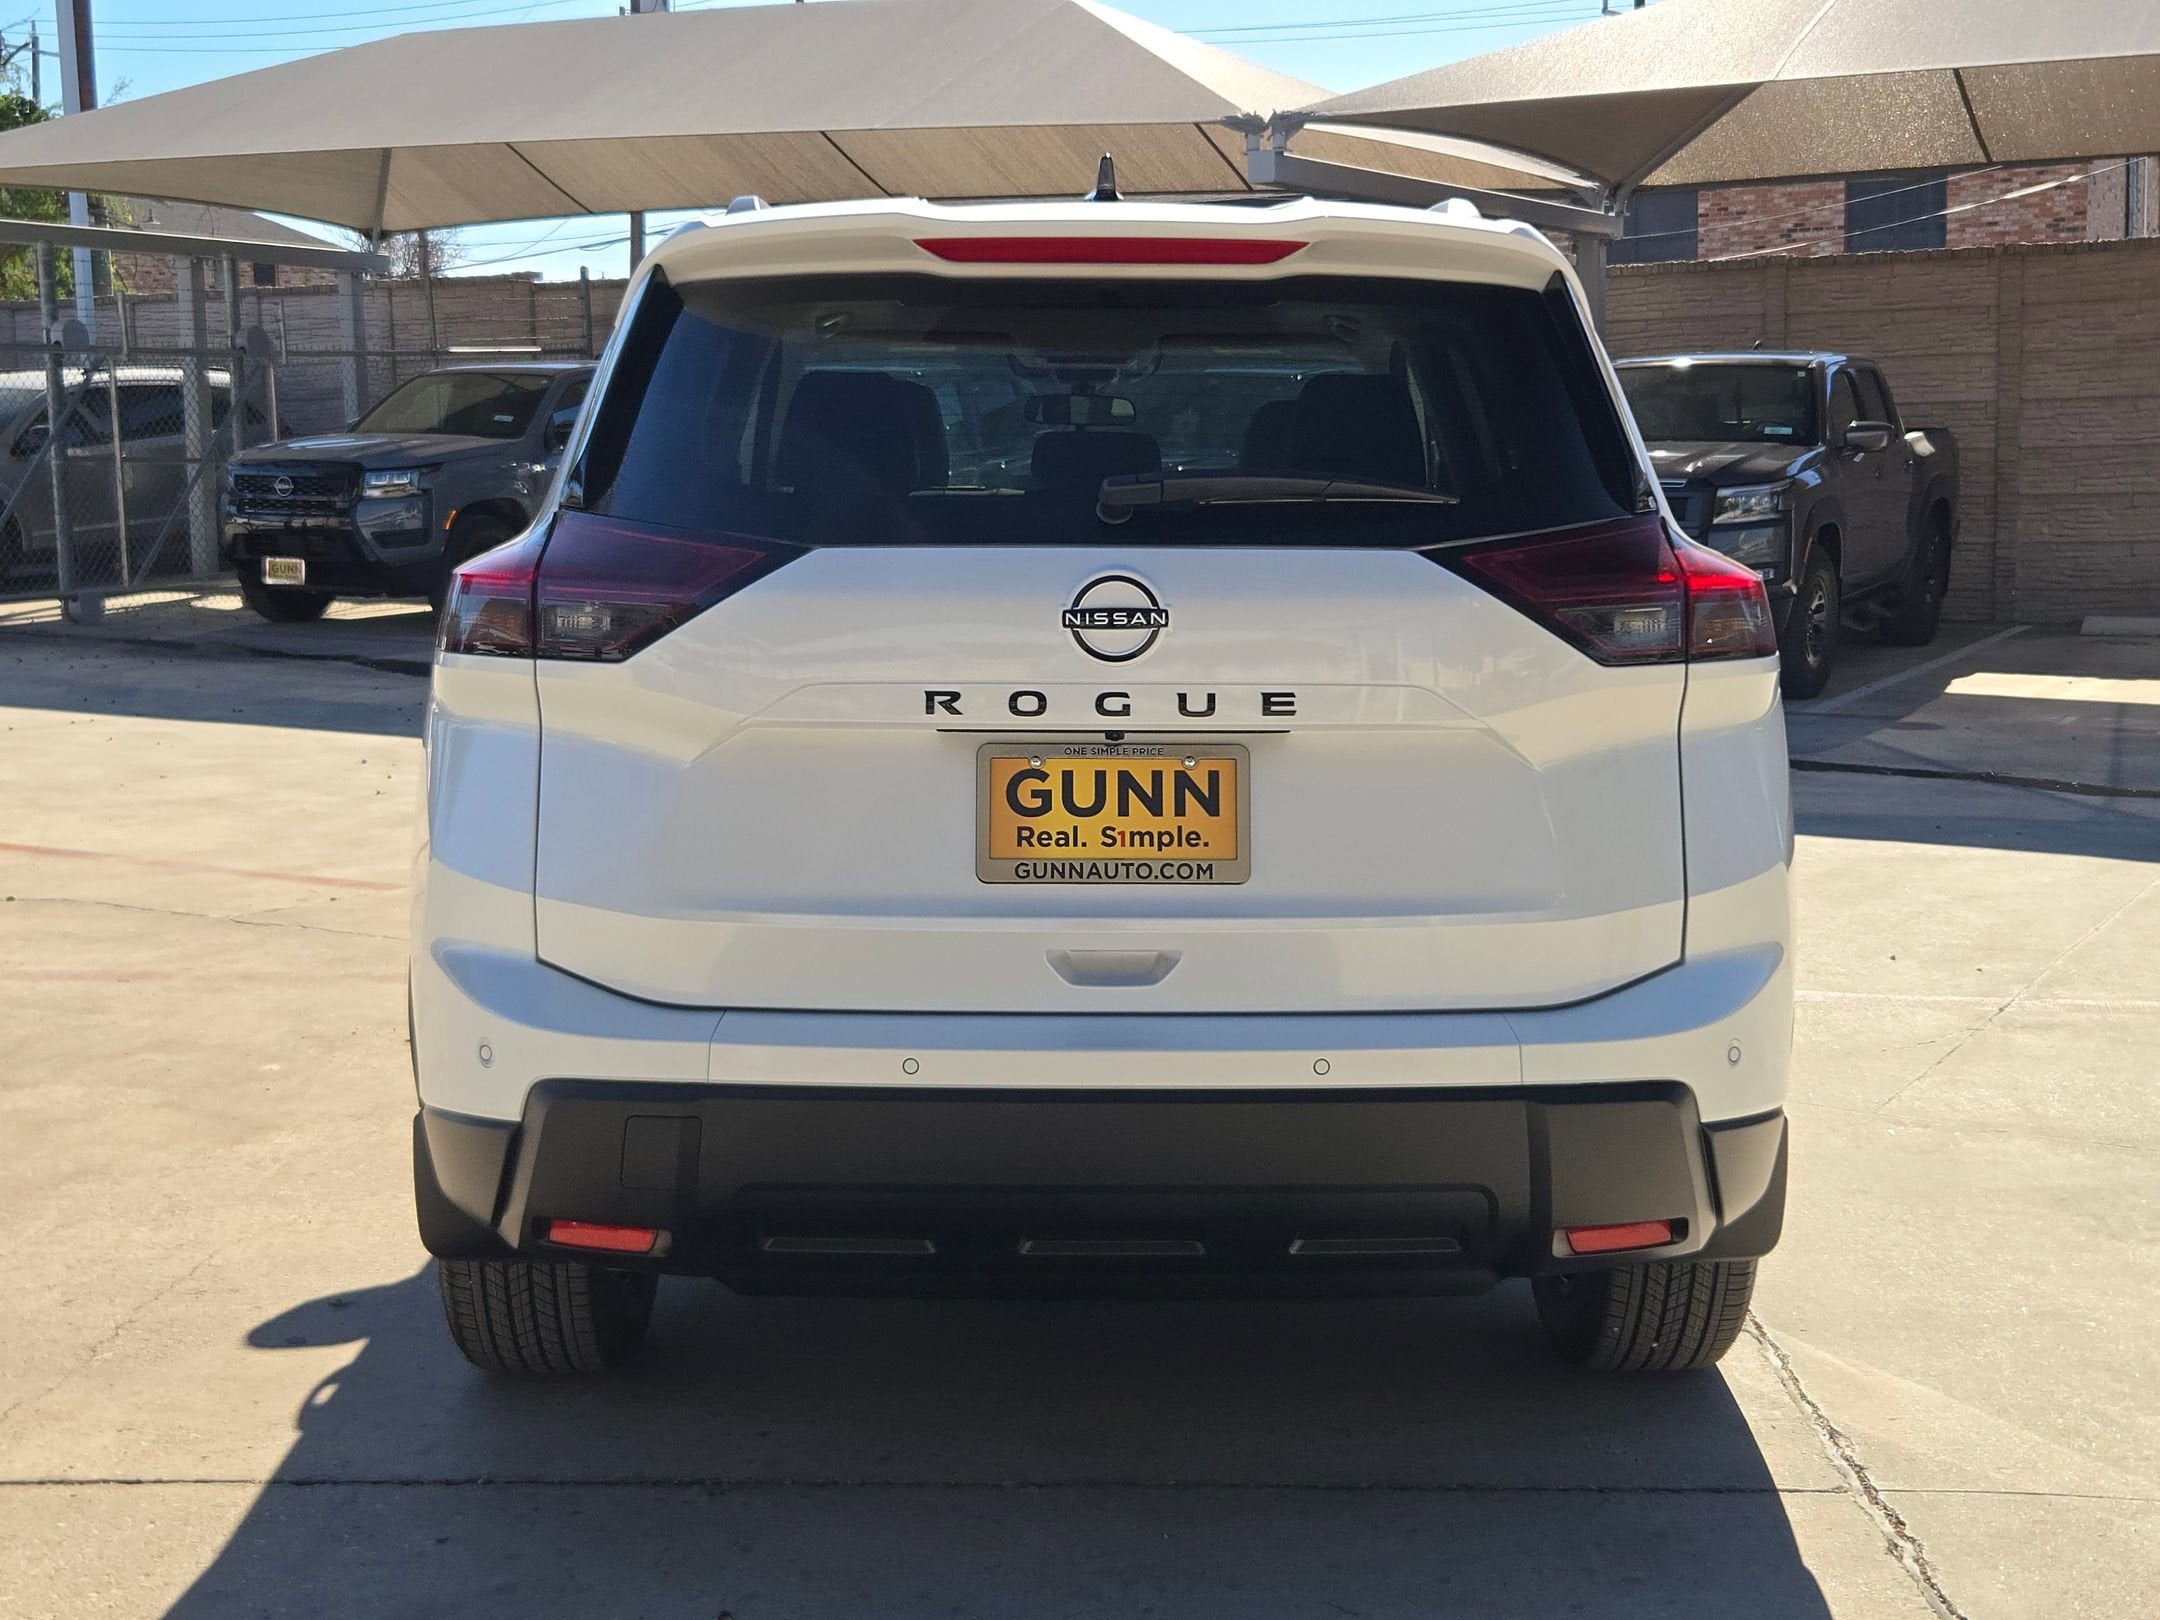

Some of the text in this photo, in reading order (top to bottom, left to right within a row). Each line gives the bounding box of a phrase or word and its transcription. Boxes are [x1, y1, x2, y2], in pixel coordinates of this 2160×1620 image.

[1065, 612, 1166, 625] NISSAN
[924, 690, 1297, 717] ROGUE
[1064, 747, 1164, 756] ONE SIMPLE PRICE
[1006, 769, 1220, 817] GUNN
[1016, 826, 1087, 847] Real.
[1014, 862, 1214, 880] GUNNAUTO.COM
